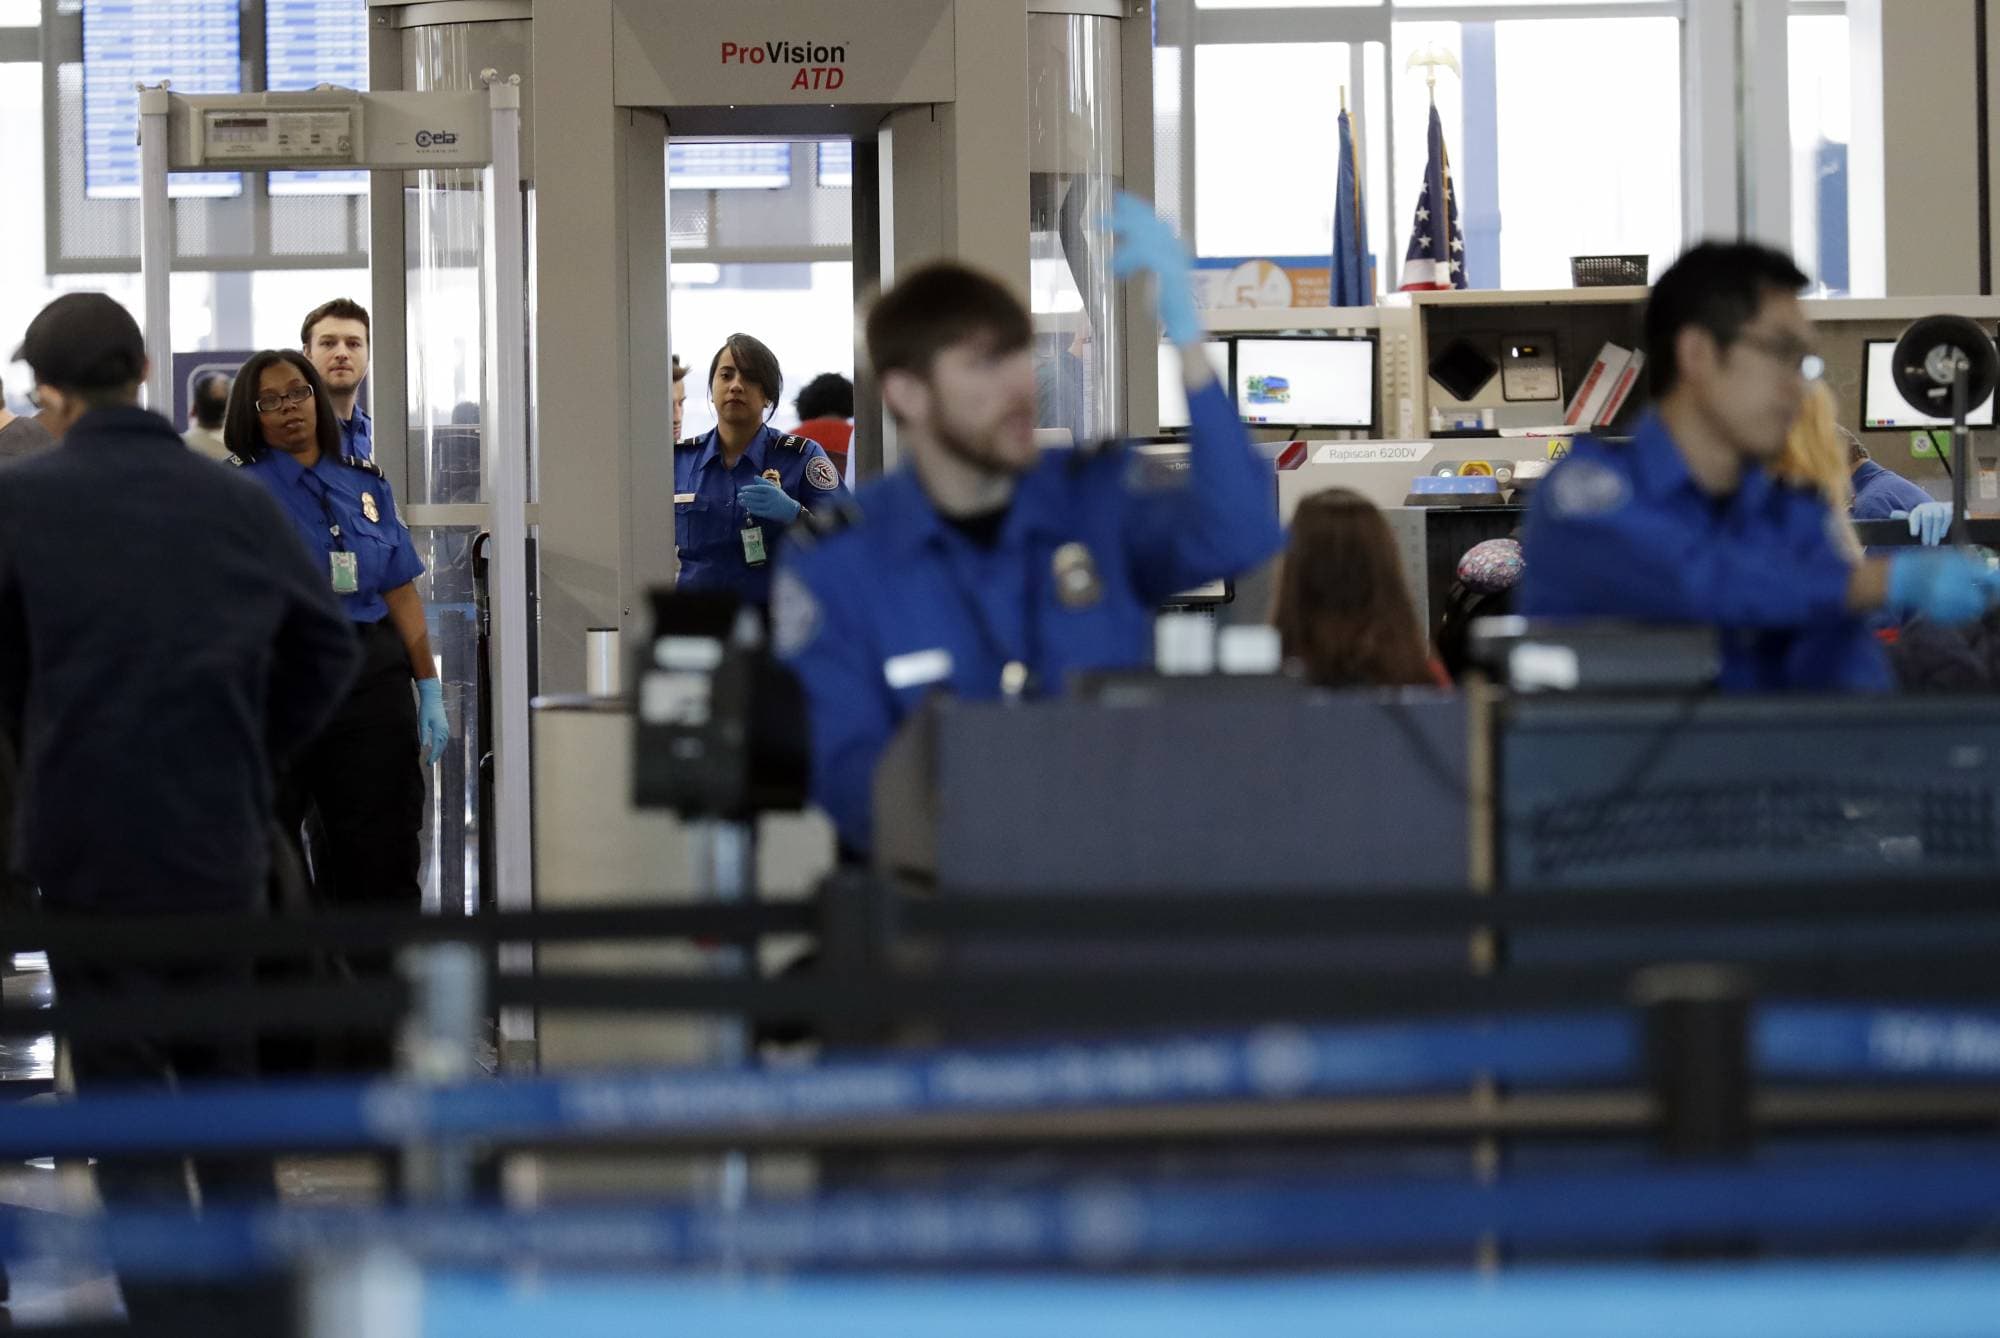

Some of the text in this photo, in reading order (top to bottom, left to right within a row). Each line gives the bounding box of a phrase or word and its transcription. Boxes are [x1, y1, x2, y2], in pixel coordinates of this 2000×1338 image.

[721, 41, 845, 64] ProVision
[791, 67, 844, 90] ATD
[1328, 447, 1417, 460] Rapiscan 620DV
